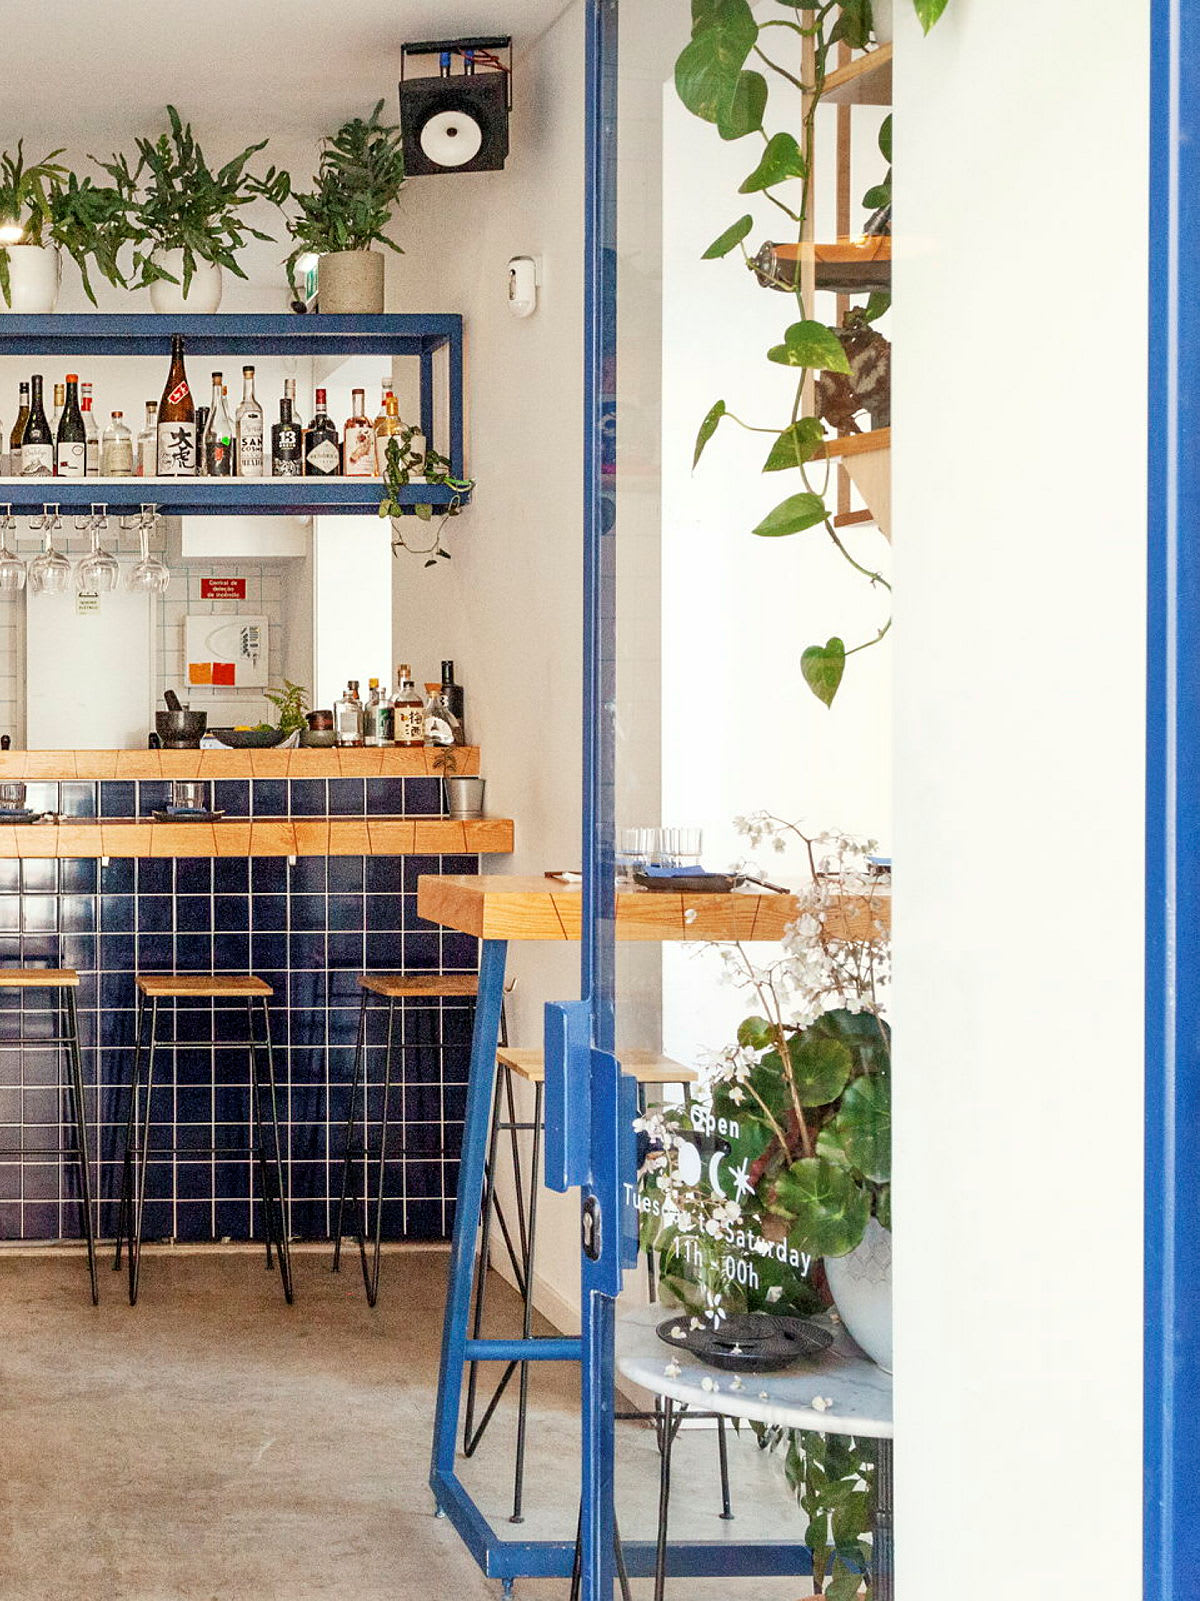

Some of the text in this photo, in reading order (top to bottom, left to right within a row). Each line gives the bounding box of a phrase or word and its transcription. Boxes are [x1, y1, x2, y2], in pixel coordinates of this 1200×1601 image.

[691, 1104, 739, 1138] Open
[674, 1236, 703, 1267] 11h
[726, 1255, 759, 1290] 00h
